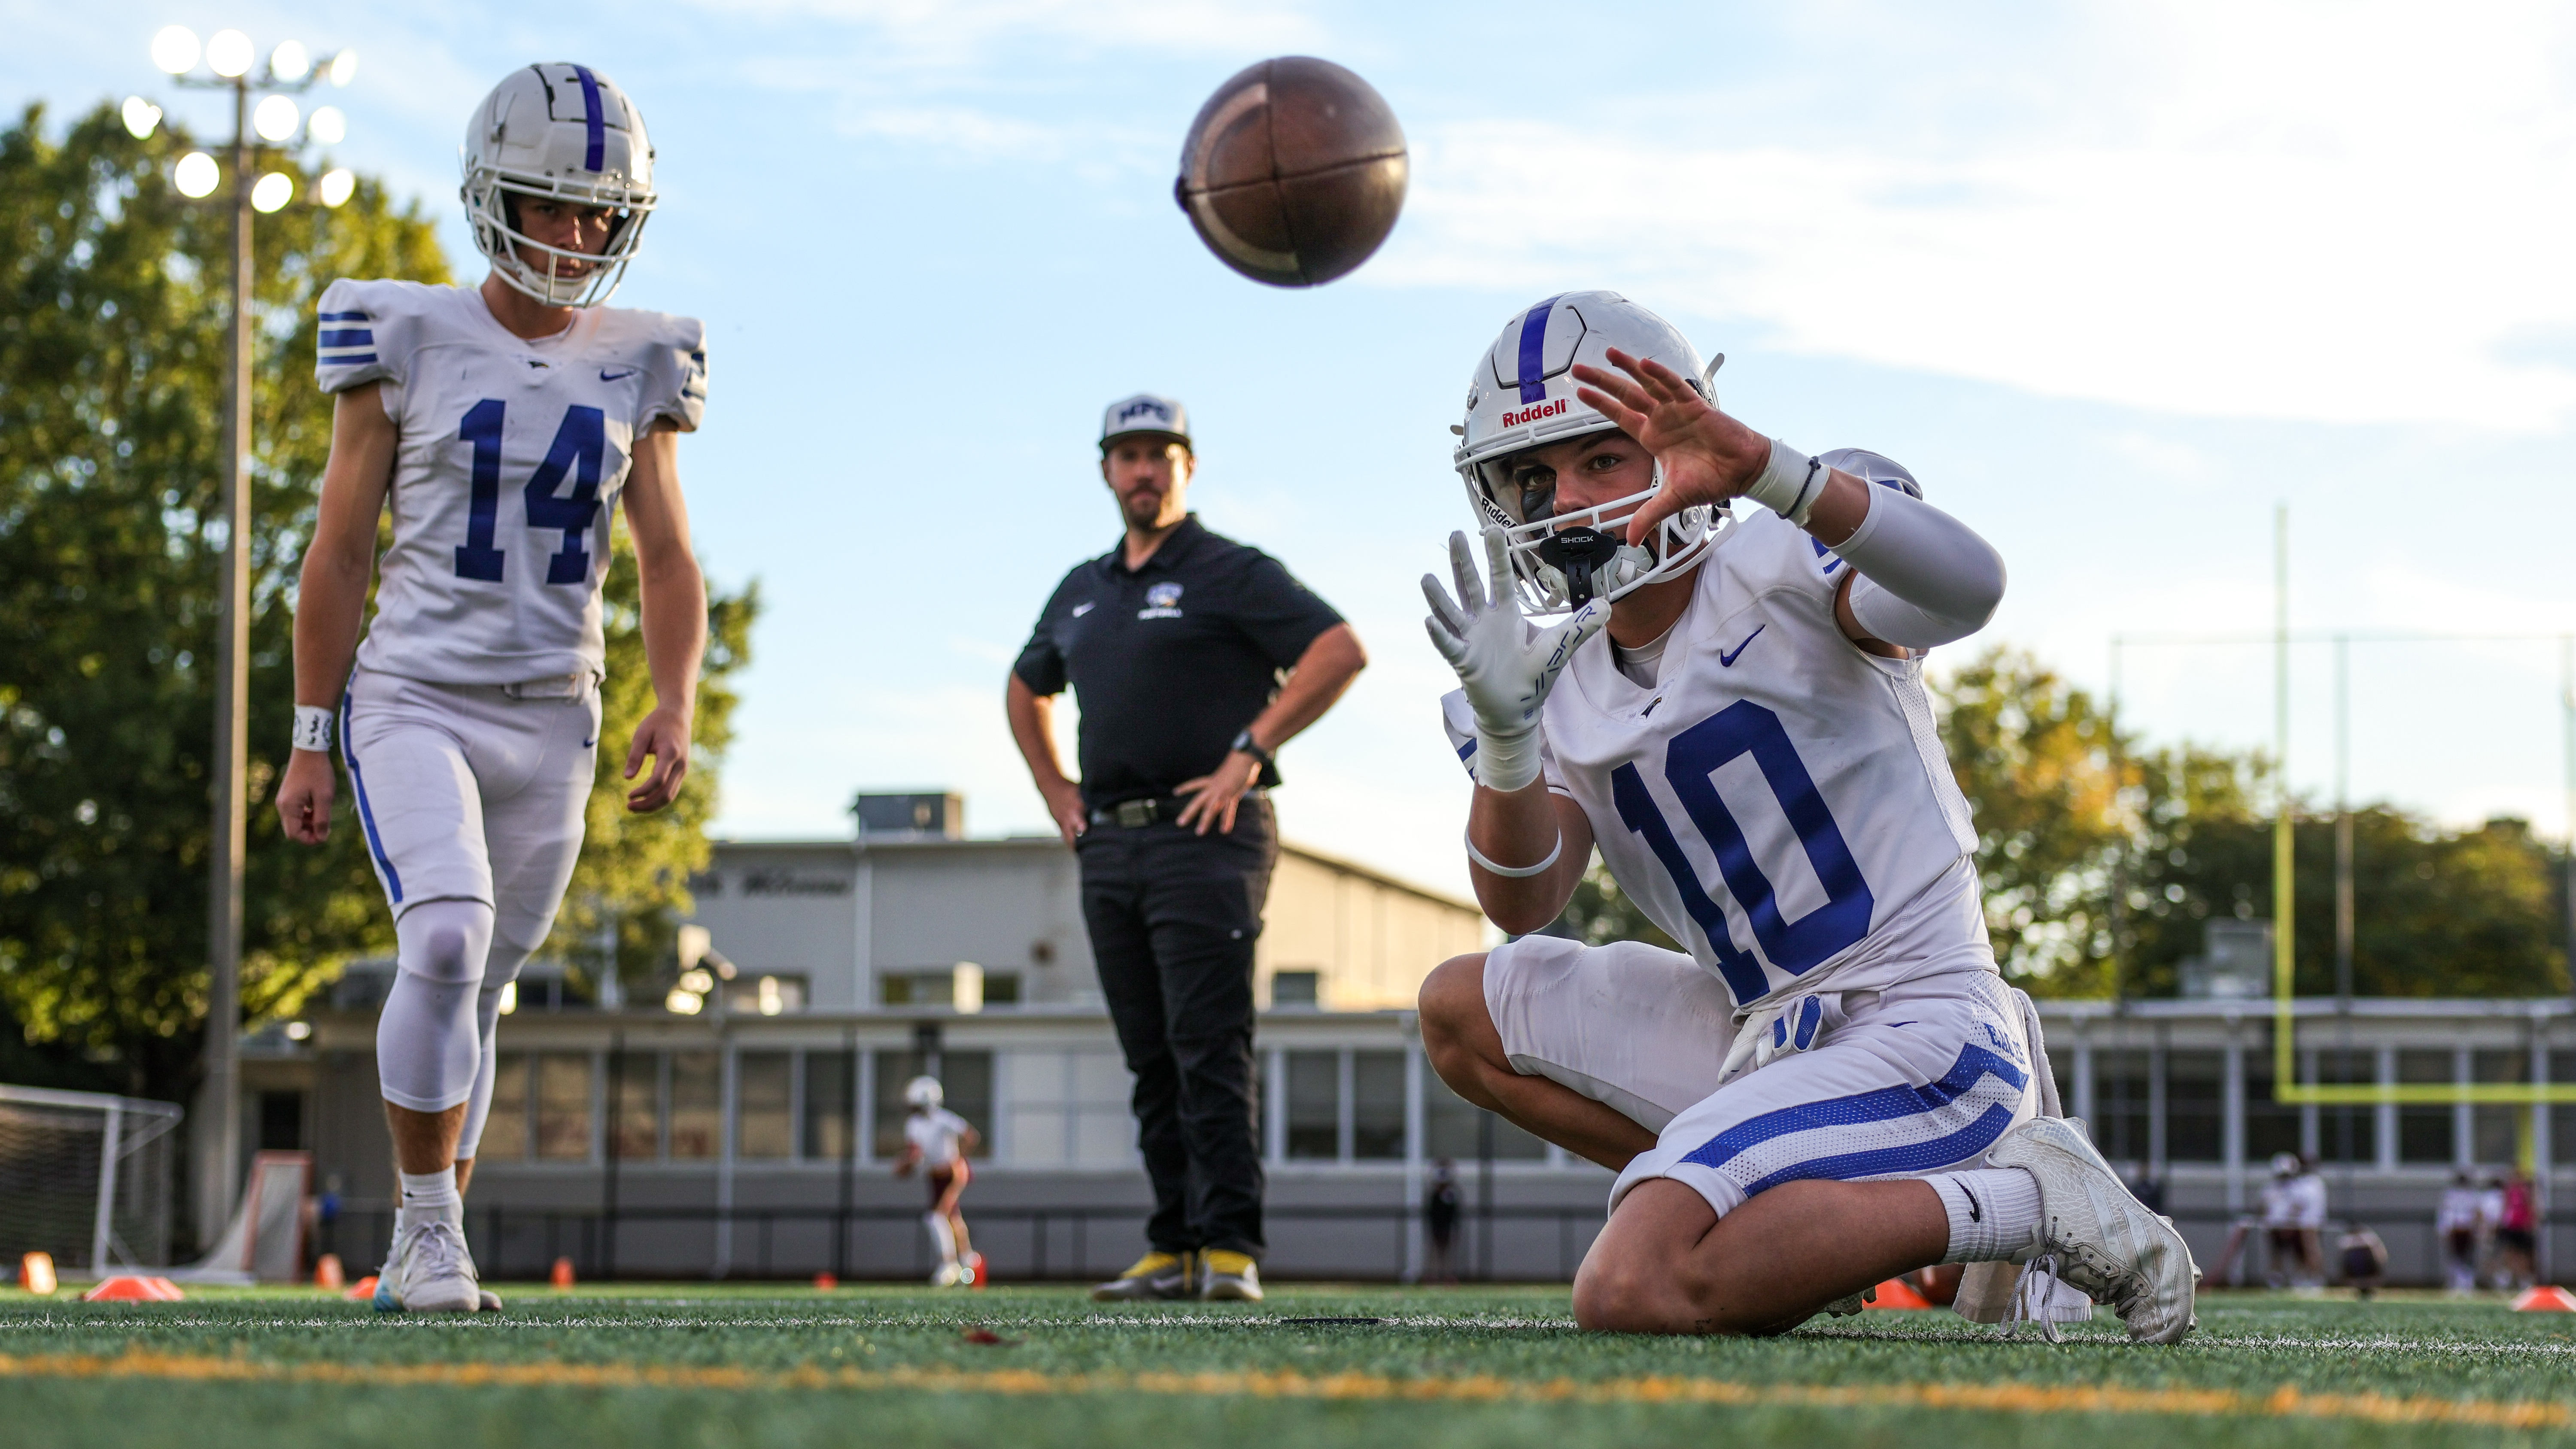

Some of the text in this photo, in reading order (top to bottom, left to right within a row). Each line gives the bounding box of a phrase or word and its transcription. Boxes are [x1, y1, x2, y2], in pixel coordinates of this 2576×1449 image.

[1502, 398, 1566, 428] Riddell
[455, 399, 604, 584] 14
[1482, 497, 1517, 529] Riddel
[1611, 699, 1874, 1005] 10
